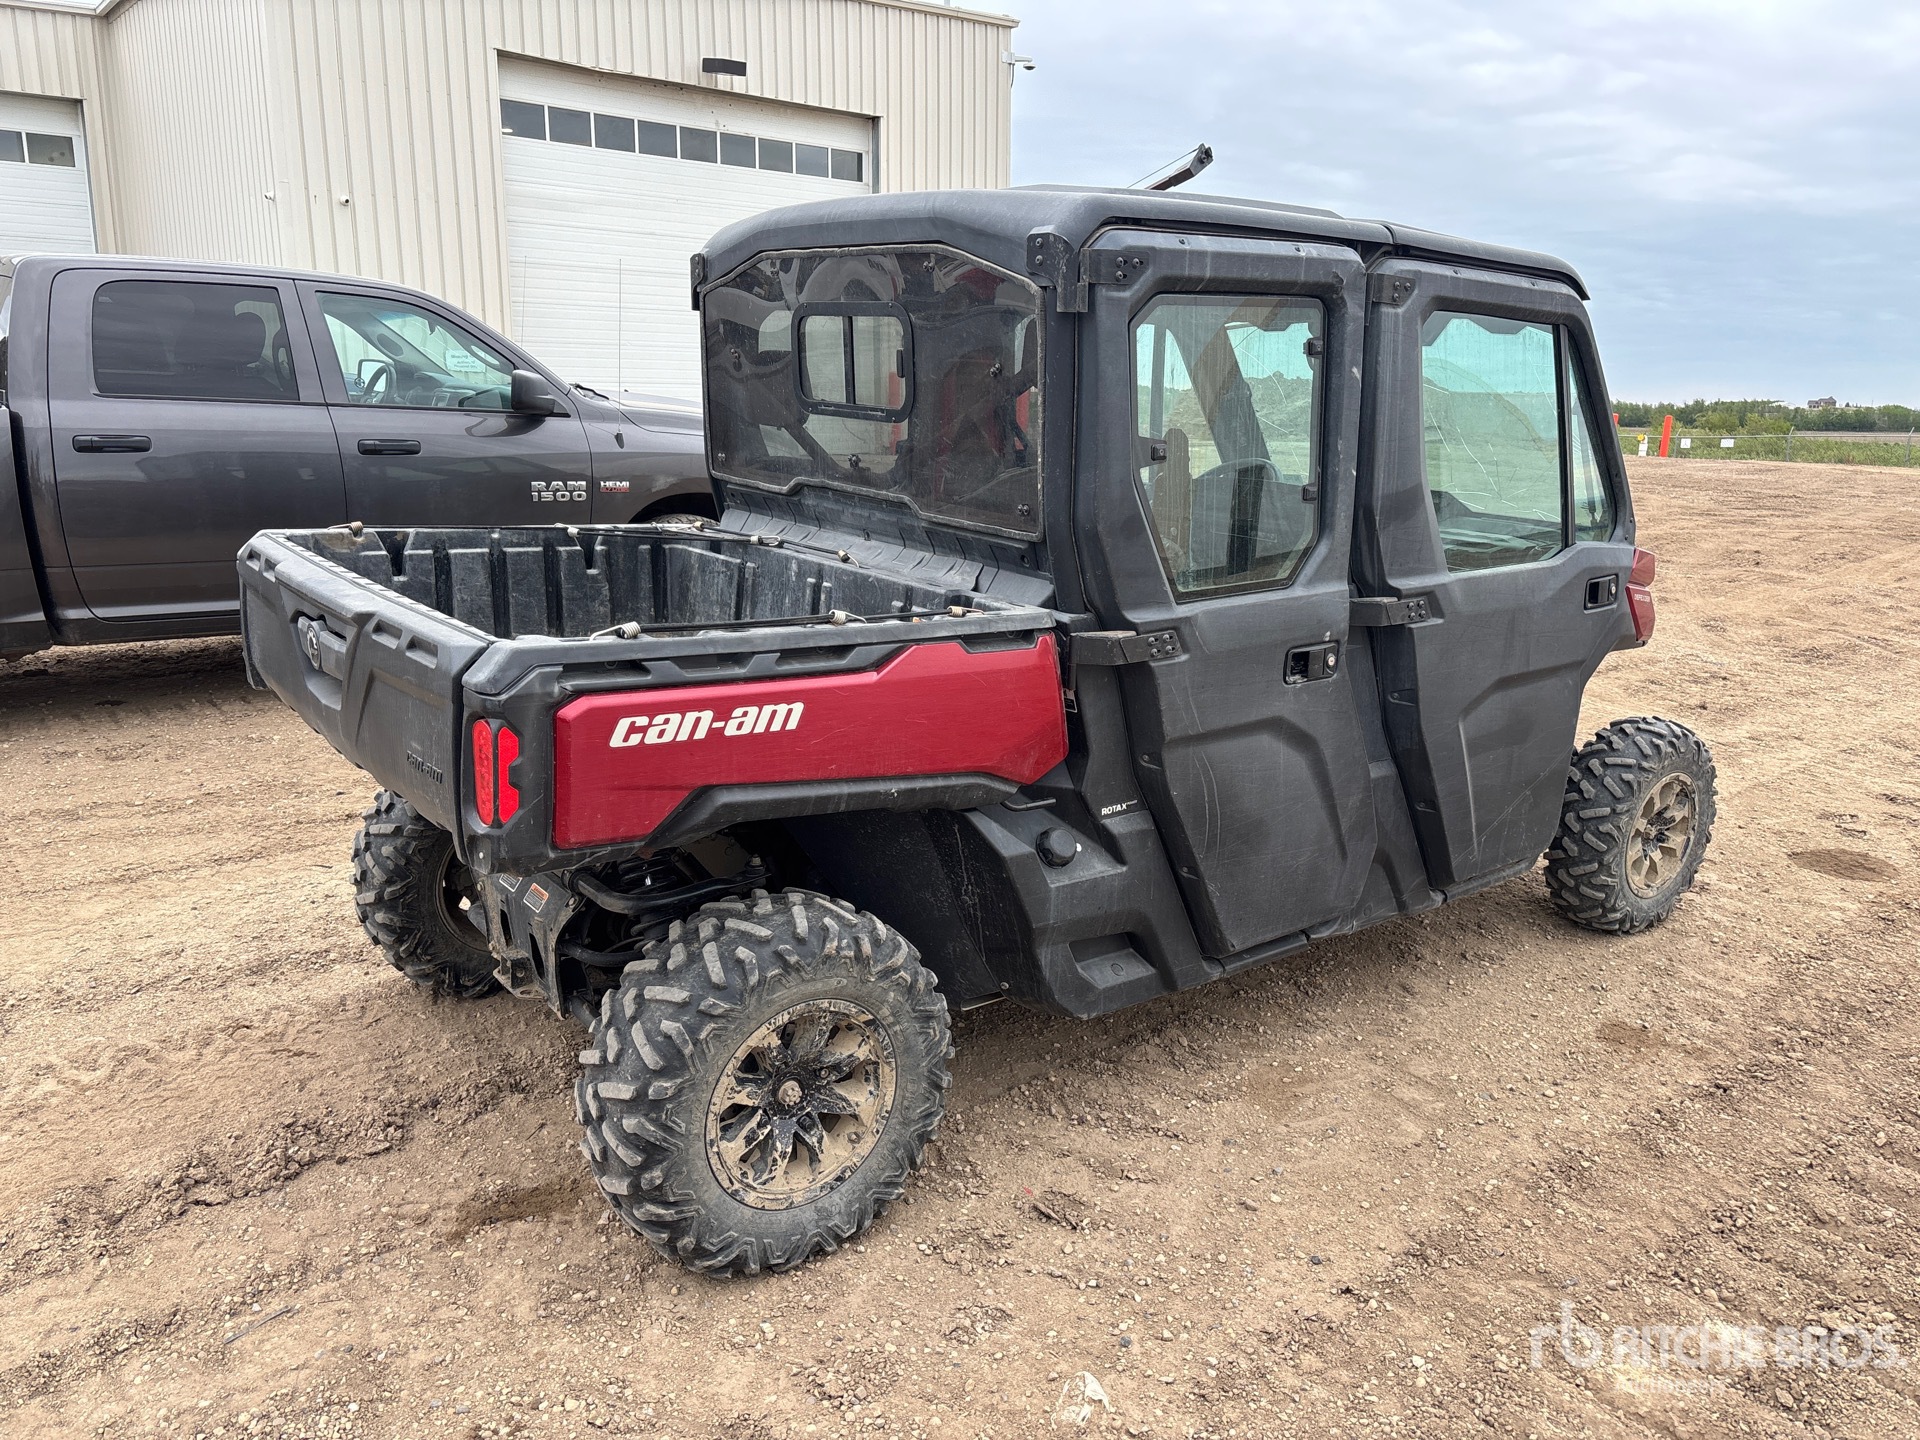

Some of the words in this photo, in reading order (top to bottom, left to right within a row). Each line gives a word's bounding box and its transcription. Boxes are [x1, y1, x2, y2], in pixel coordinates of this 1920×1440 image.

[530, 481, 587, 491] RAM
[531, 491, 587, 502] 1500
[609, 701, 805, 748] can-am
[406, 750, 443, 784] can-am
[1101, 803, 1127, 816] ROTAX
